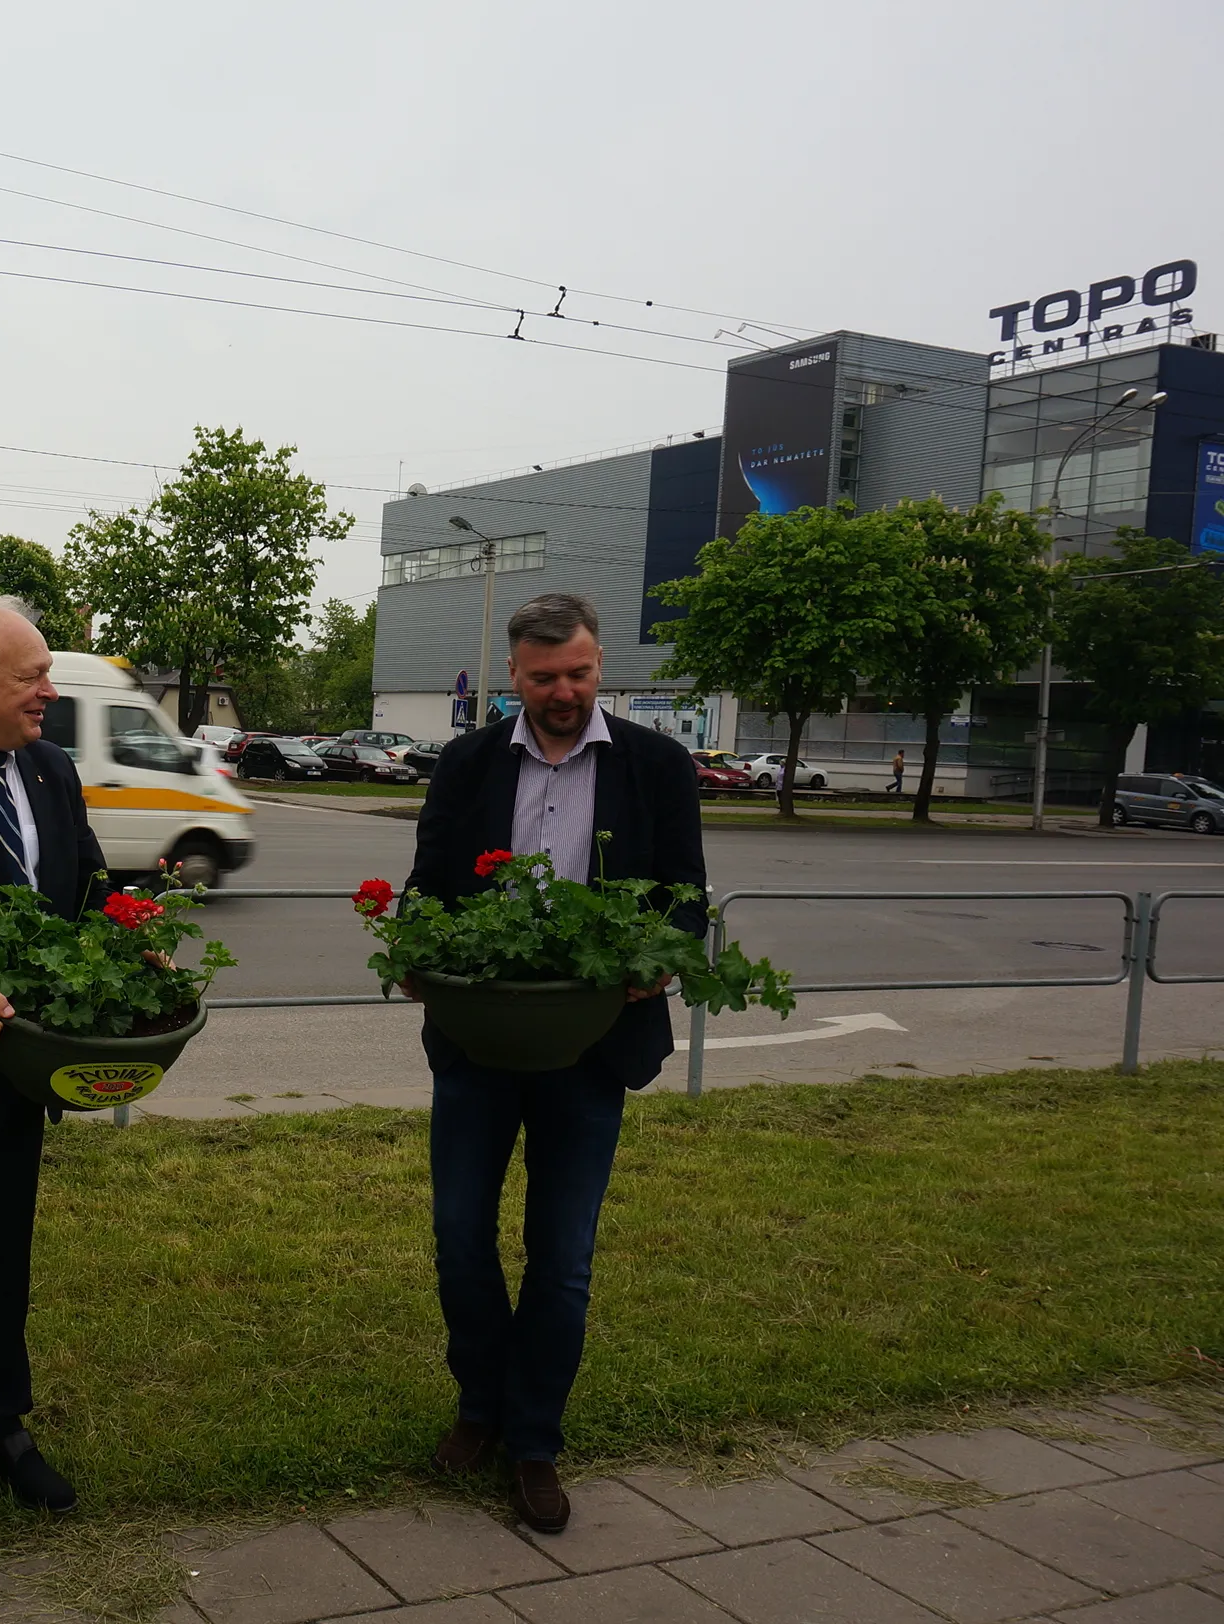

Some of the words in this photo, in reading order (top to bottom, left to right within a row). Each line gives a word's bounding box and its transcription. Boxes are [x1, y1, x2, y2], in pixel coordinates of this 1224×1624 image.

[989, 259, 1197, 342] TOPO
[988, 308, 1193, 366] CENTRAS
[789, 352, 831, 370] SAMSUNG
[750, 459, 768, 468] DAR
[76, 1085, 143, 1102] KAUNAS
